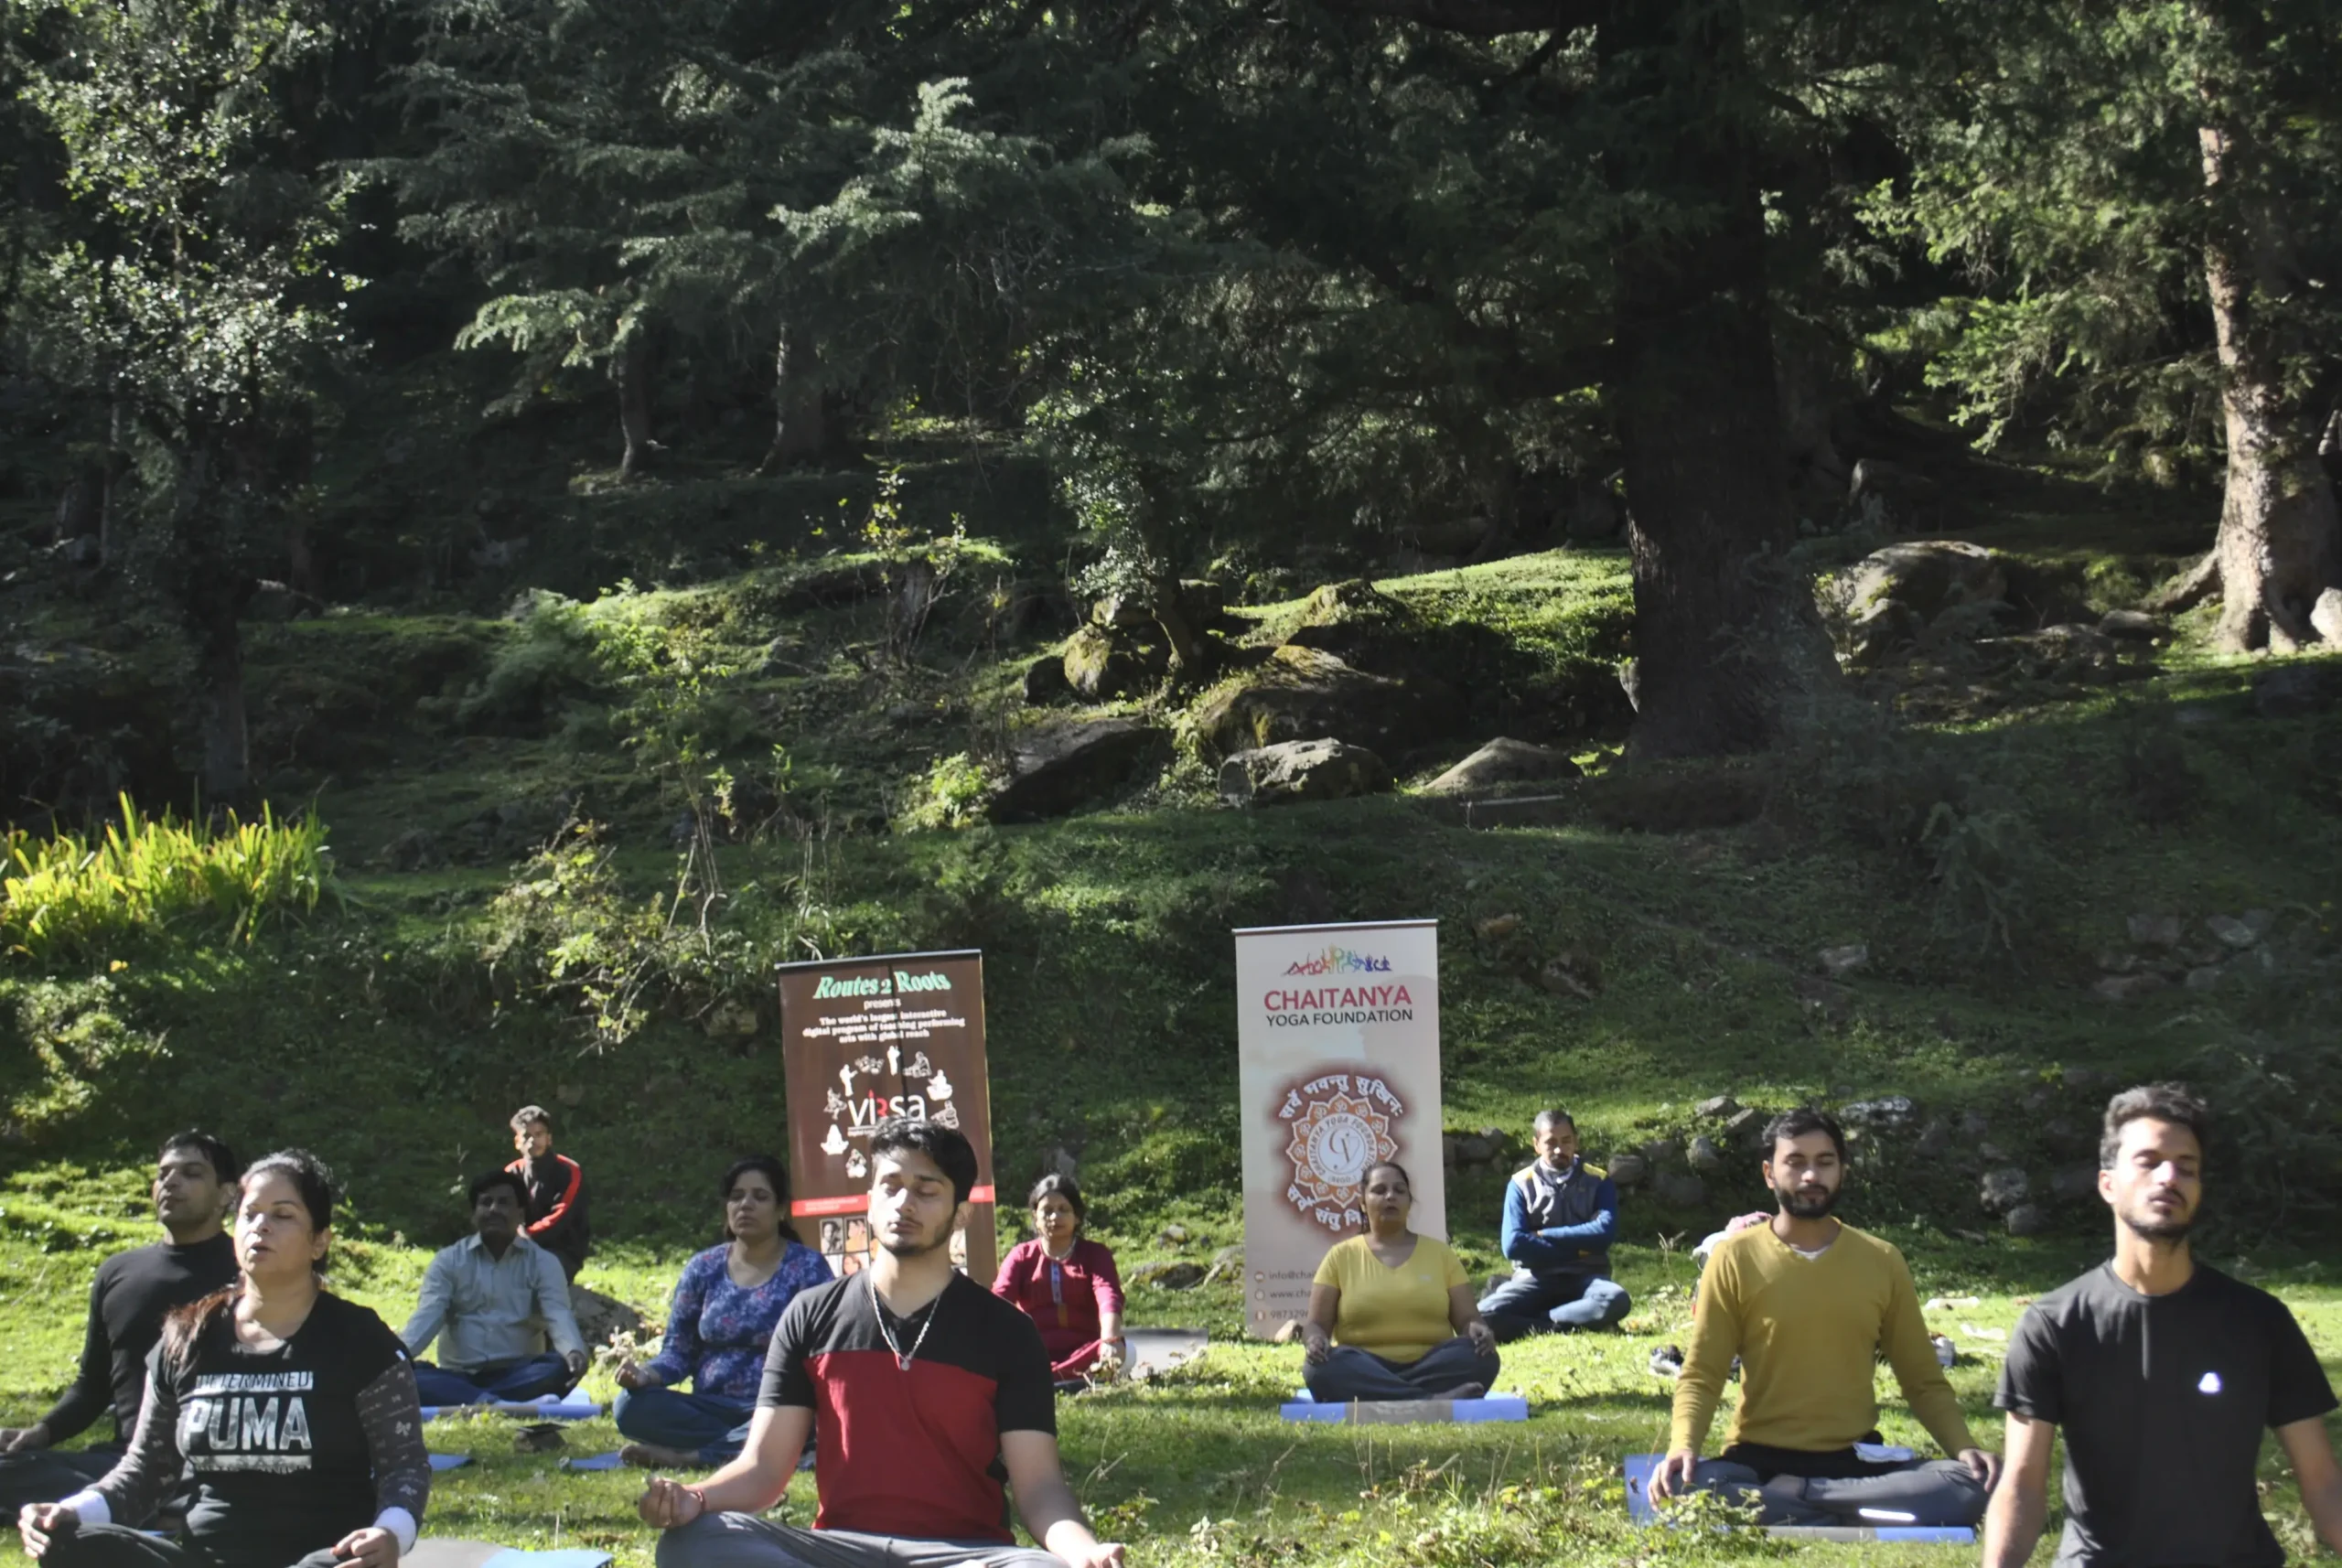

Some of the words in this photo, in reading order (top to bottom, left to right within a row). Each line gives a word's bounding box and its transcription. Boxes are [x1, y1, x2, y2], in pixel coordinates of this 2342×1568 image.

[812, 975, 879, 999] Routes
[881, 978, 893, 994] 2
[894, 971, 952, 993] Roots
[1263, 985, 1413, 1011] CHAITANYA
[802, 1026, 831, 1038] digital
[868, 1022, 878, 1032] of
[918, 1016, 966, 1029] performing
[819, 1016, 837, 1026] The
[900, 1009, 947, 1020] interactive
[1266, 1014, 1310, 1027] YOGA
[1313, 1009, 1413, 1025] FOUNDATION
[857, 1032, 877, 1041] with
[906, 1028, 930, 1038] reach
[1270, 1288, 1312, 1298] www.cha
[185, 1396, 313, 1450] PUMA
